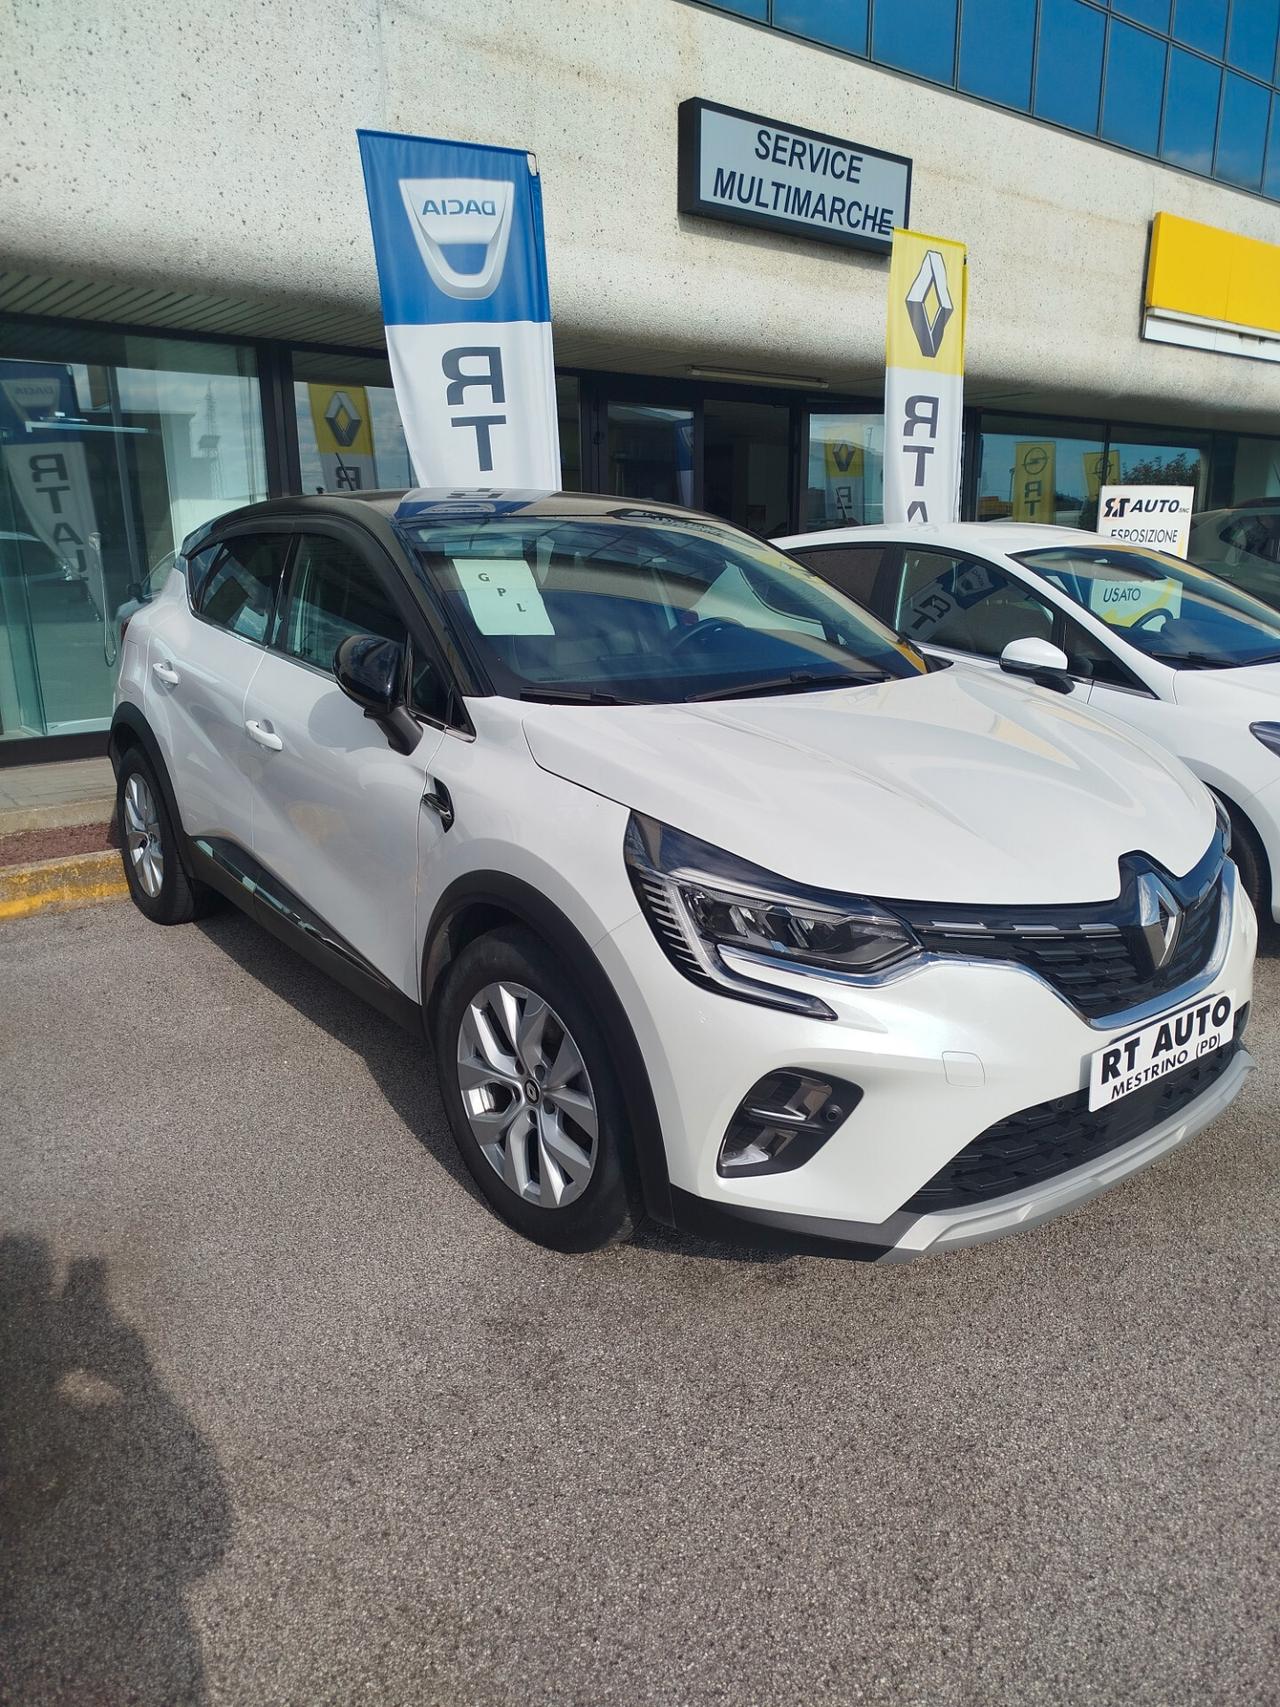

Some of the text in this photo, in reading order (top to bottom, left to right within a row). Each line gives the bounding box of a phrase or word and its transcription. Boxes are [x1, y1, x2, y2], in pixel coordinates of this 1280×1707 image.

[755, 130, 863, 184] SERVICE
[713, 167, 894, 236] MULTIMARCHE
[1130, 499, 1180, 513] AUTO
[1111, 529, 1178, 543] ESPOSIZIONE
[1103, 587, 1141, 602] USATO
[1101, 996, 1231, 1085] RT AUTO
[1111, 1033, 1221, 1099] MESTRINO (PD)
